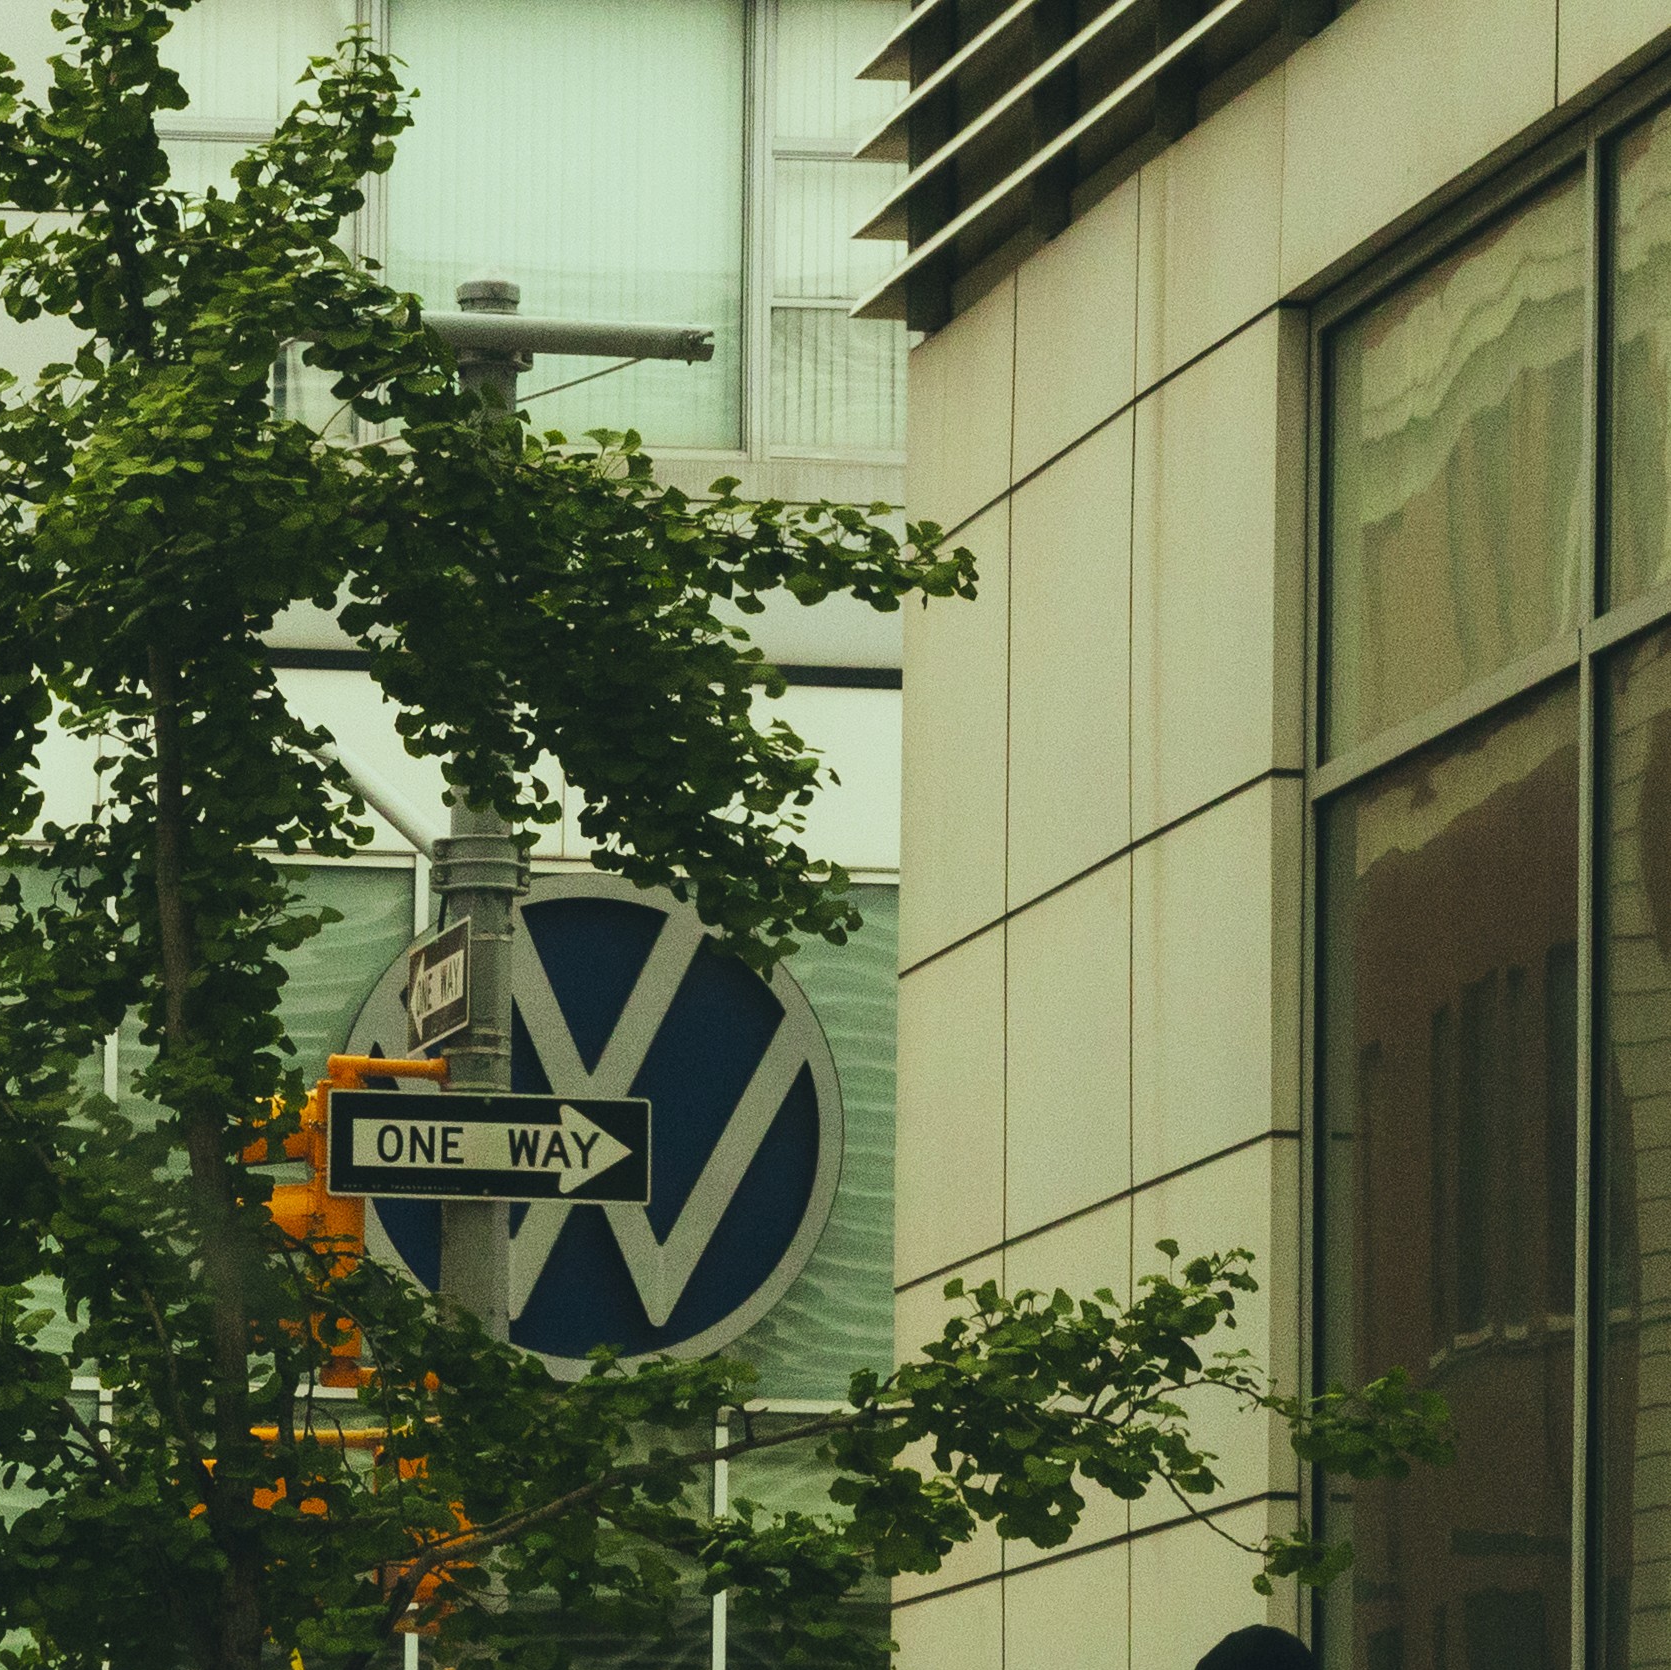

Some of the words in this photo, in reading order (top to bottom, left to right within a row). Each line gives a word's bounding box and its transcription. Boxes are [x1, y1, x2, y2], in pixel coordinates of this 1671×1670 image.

[416, 972, 433, 1018] ONE
[440, 956, 461, 1003] WAY
[376, 1124, 465, 1164] ONE
[508, 1128, 601, 1169] WAY
